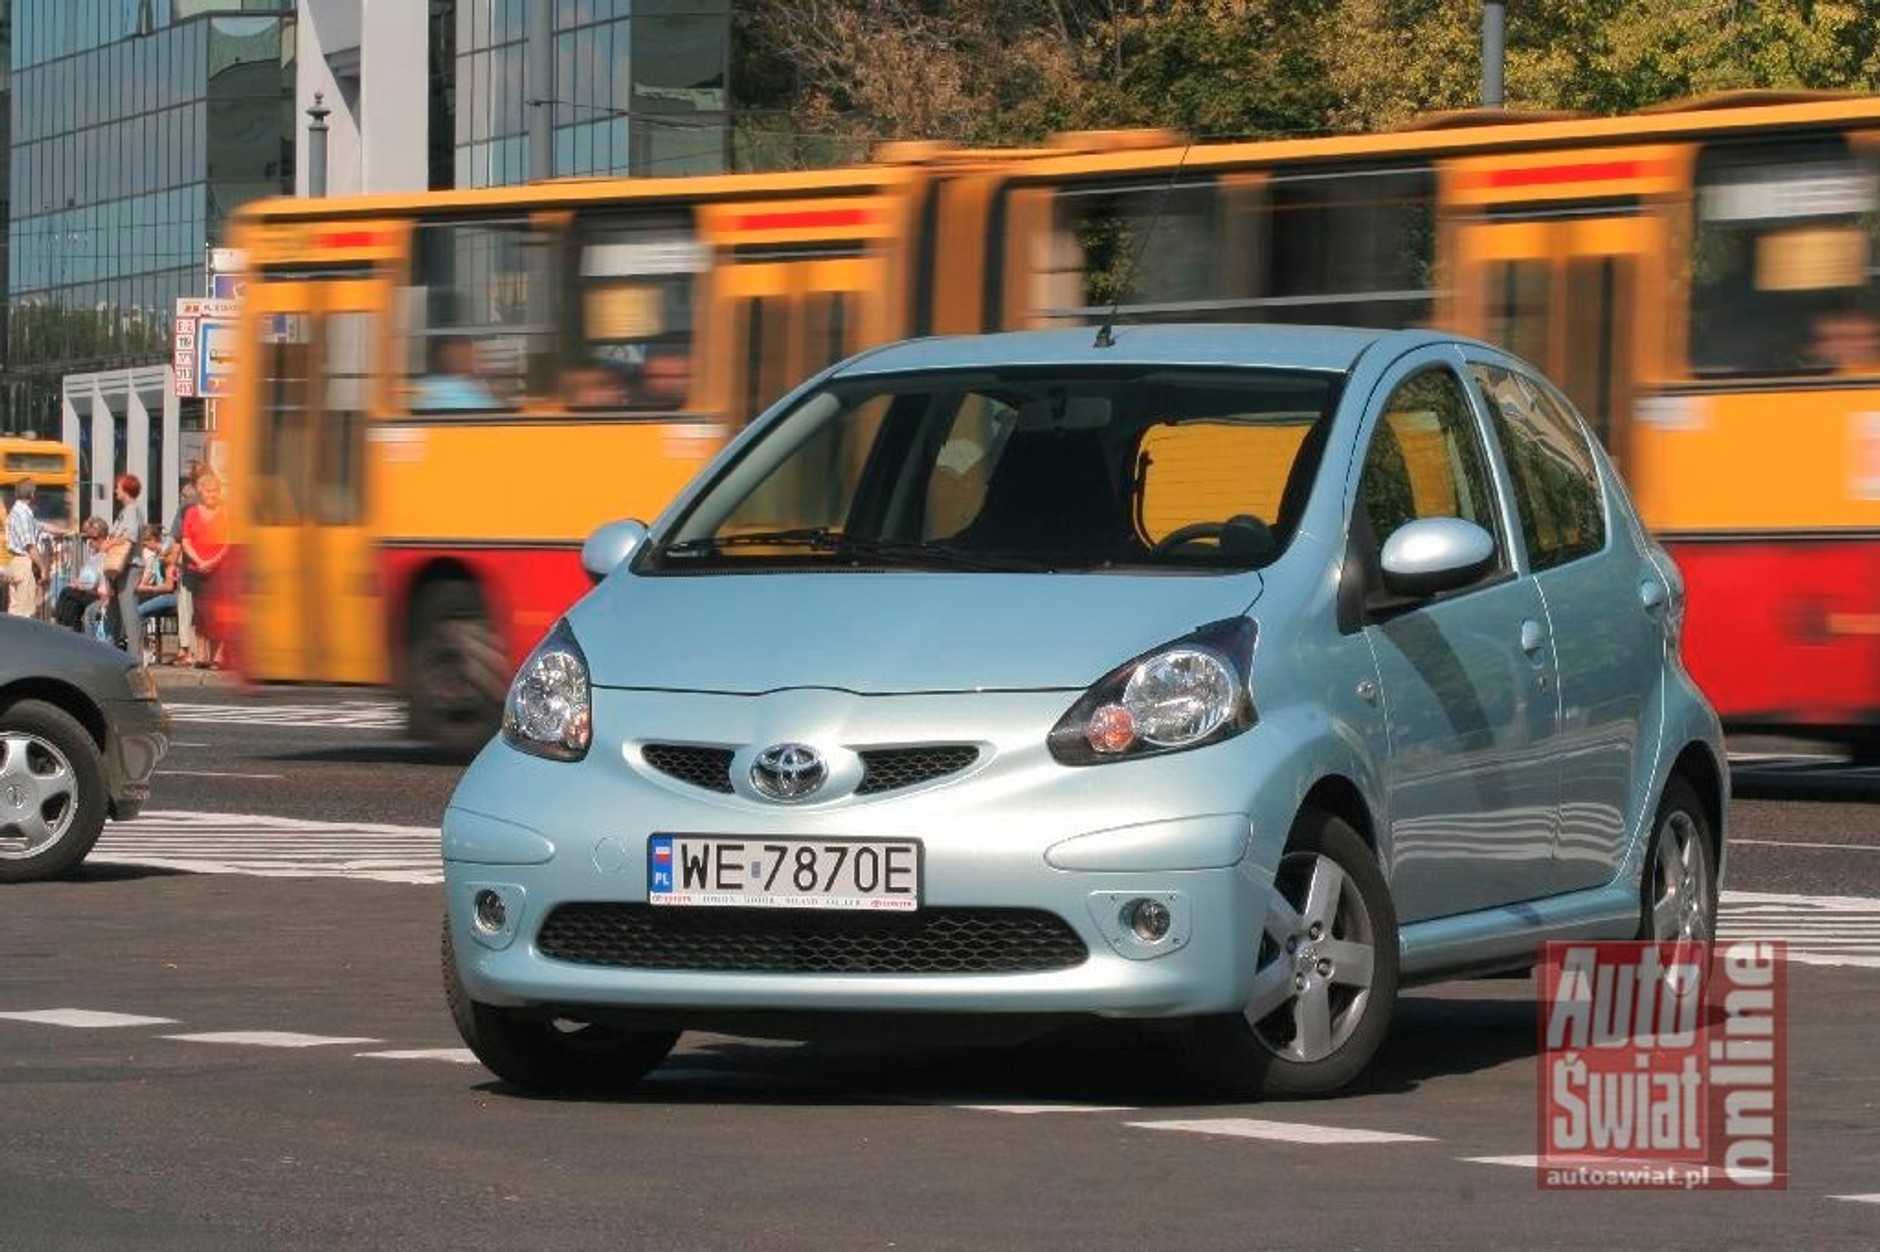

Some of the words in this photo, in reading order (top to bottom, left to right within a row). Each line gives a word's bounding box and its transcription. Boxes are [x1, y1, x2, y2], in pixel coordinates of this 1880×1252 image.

[654, 871, 670, 886] PL
[681, 843, 745, 890] WE
[763, 845, 912, 893] 7870E
